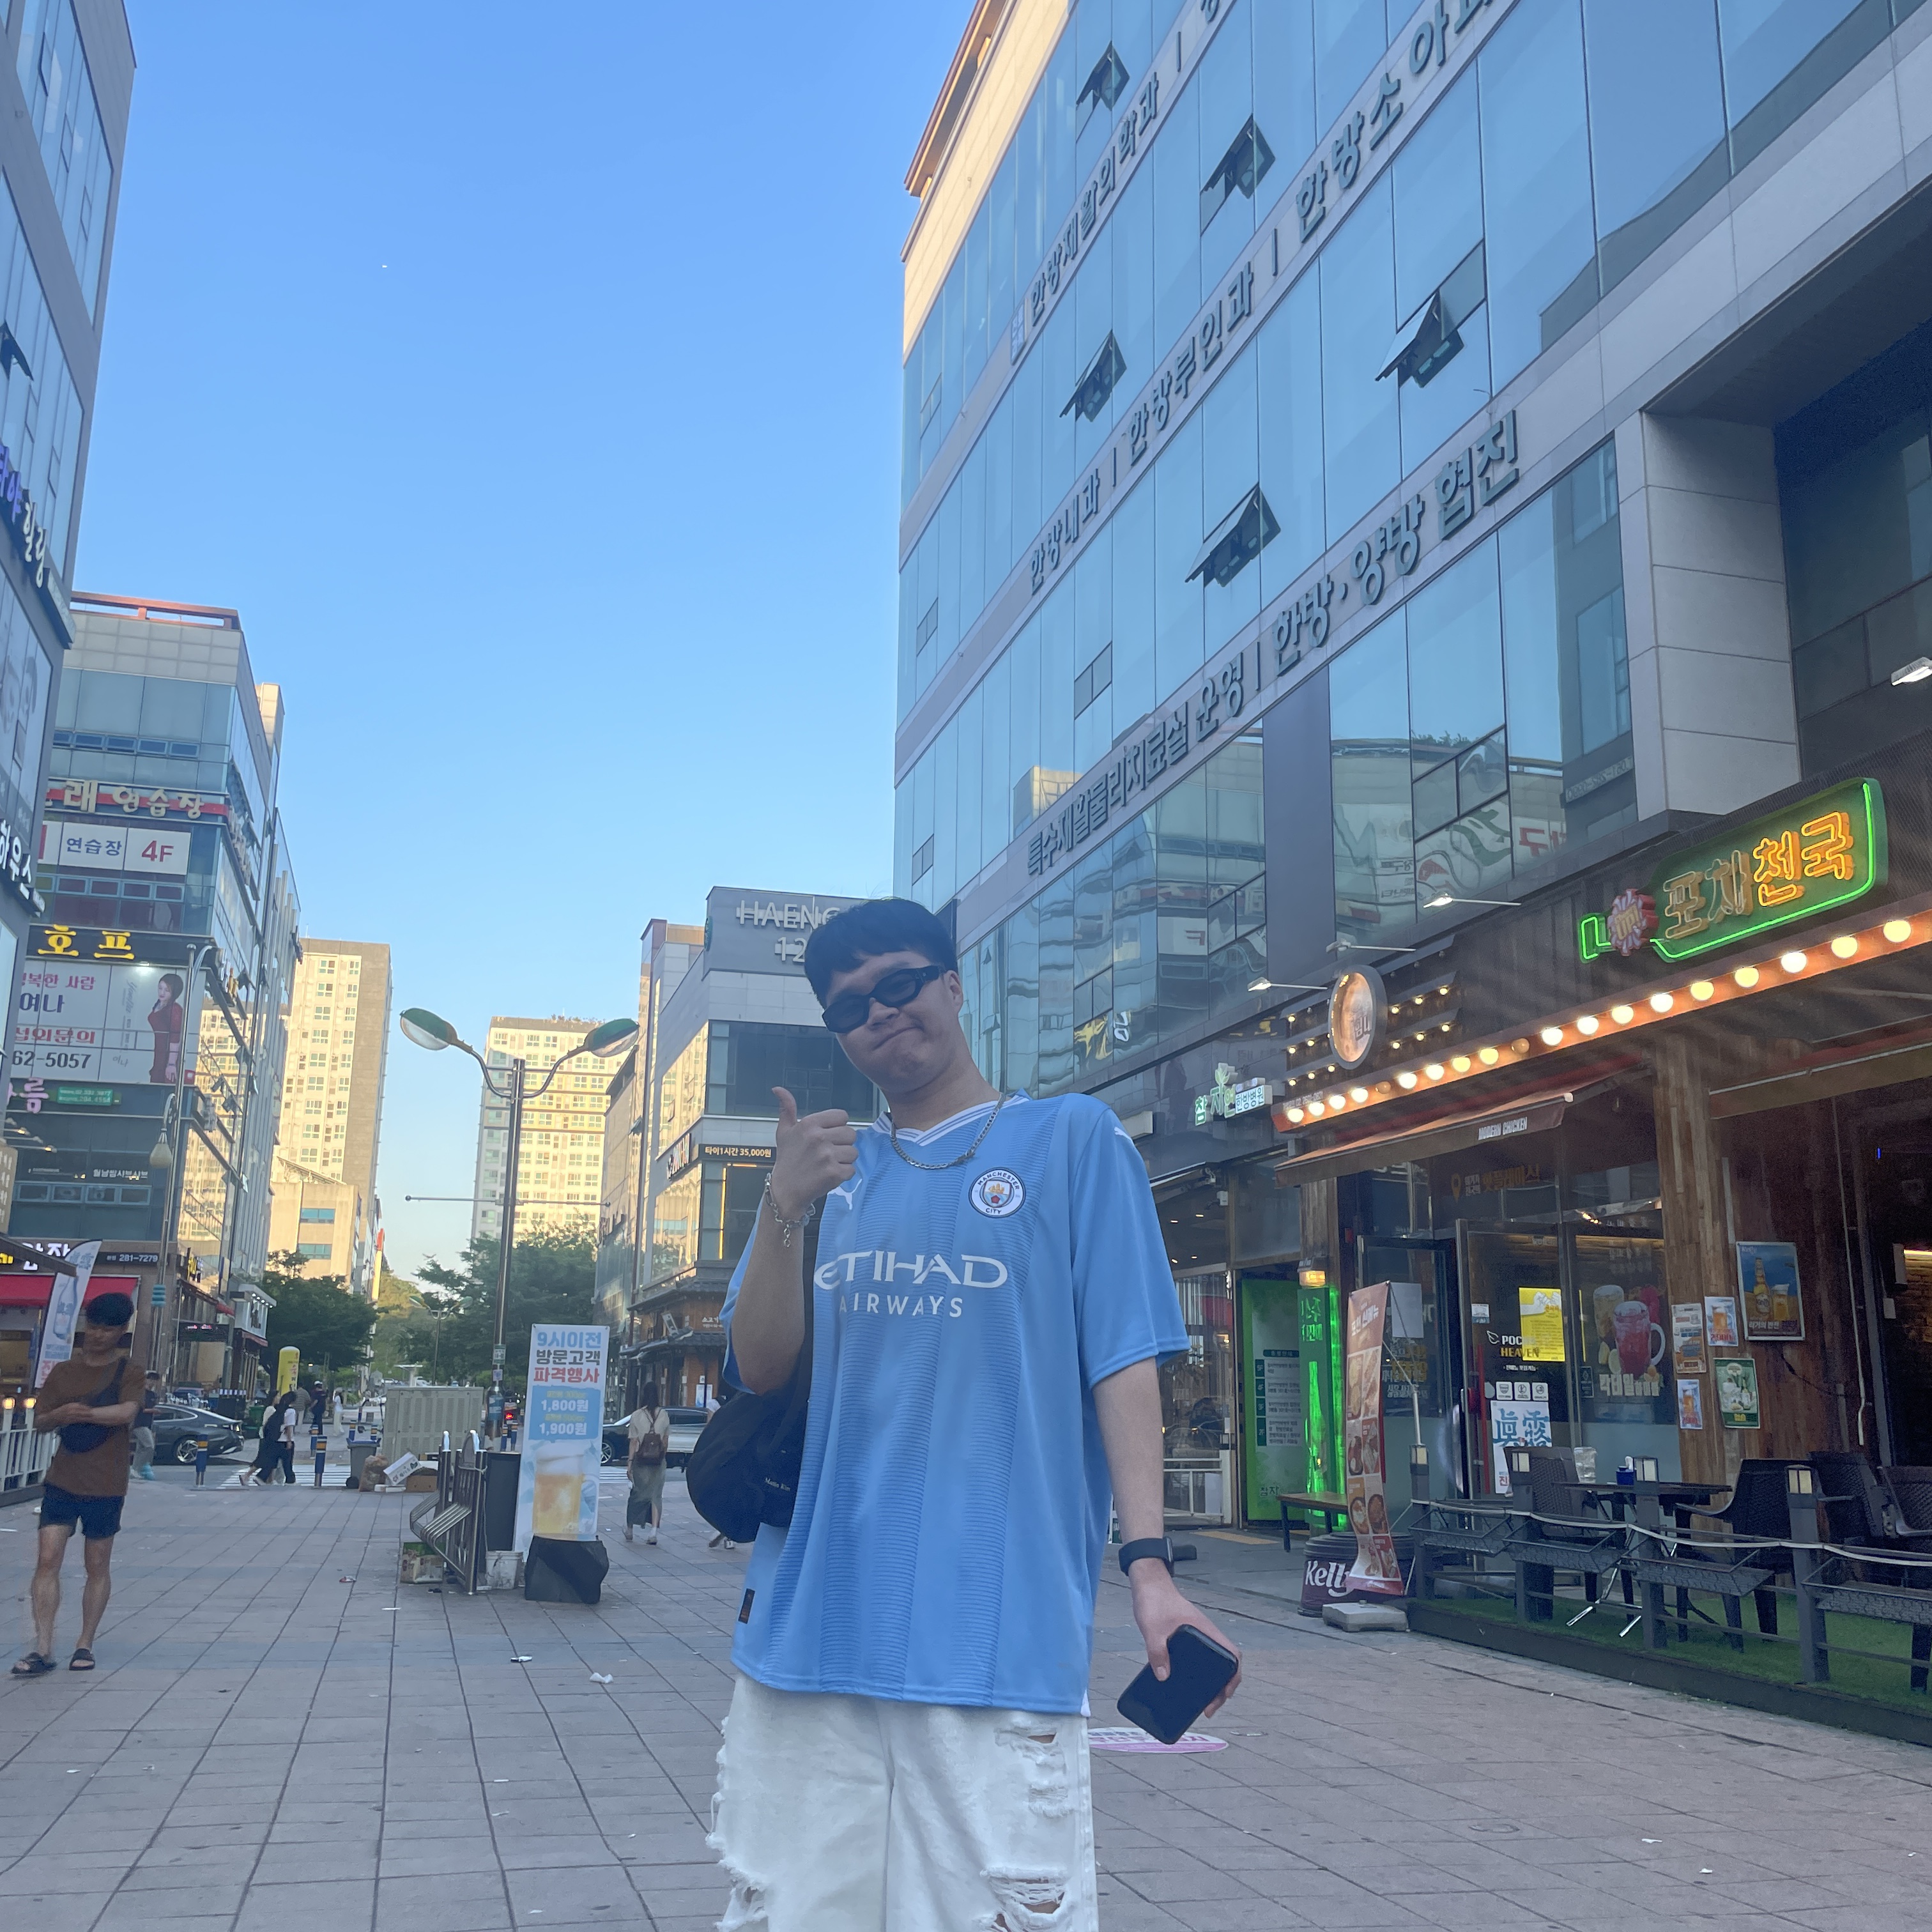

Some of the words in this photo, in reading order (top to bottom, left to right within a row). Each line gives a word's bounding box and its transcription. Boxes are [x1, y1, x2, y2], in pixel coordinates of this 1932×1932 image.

[1031, 72, 1160, 327] 한방재활의학과
[1030, 468, 1100, 595] 한방내과
[1129, 261, 1255, 466] 한방부인과
[1027, 702, 1188, 875] 특수재활물리치료실
[1195, 652, 1244, 742] 운영
[1435, 410, 1520, 540] 협진
[46, 779, 204, 819] 래연습장
[66, 837, 122, 856] 연습장
[141, 840, 174, 862] 4F
[1663, 811, 1854, 939] 포차천국
[38, 924, 135, 960] 호프
[66, 975, 96, 990] 사람
[1236, 1086, 1264, 1113] 한방병원
[1503, 1117, 1528, 1135] CHICKEN
[739, 1147, 771, 1157] 35,000원
[977, 1171, 1020, 1190] MANCHESTER
[119, 1254, 158, 1262] 281-7279
[813, 1250, 1008, 1291] ETIHAD
[839, 1292, 963, 1318] AIRWAYS
[537, 1331, 601, 1349] 9시이전
[537, 1349, 601, 1365] 방문고객
[1501, 1347, 1539, 1358] HEAVEN
[533, 1367, 599, 1383] 파격행사
[541, 1399, 588, 1413] 1,800원
[539, 1423, 586, 1436] 1,900원
